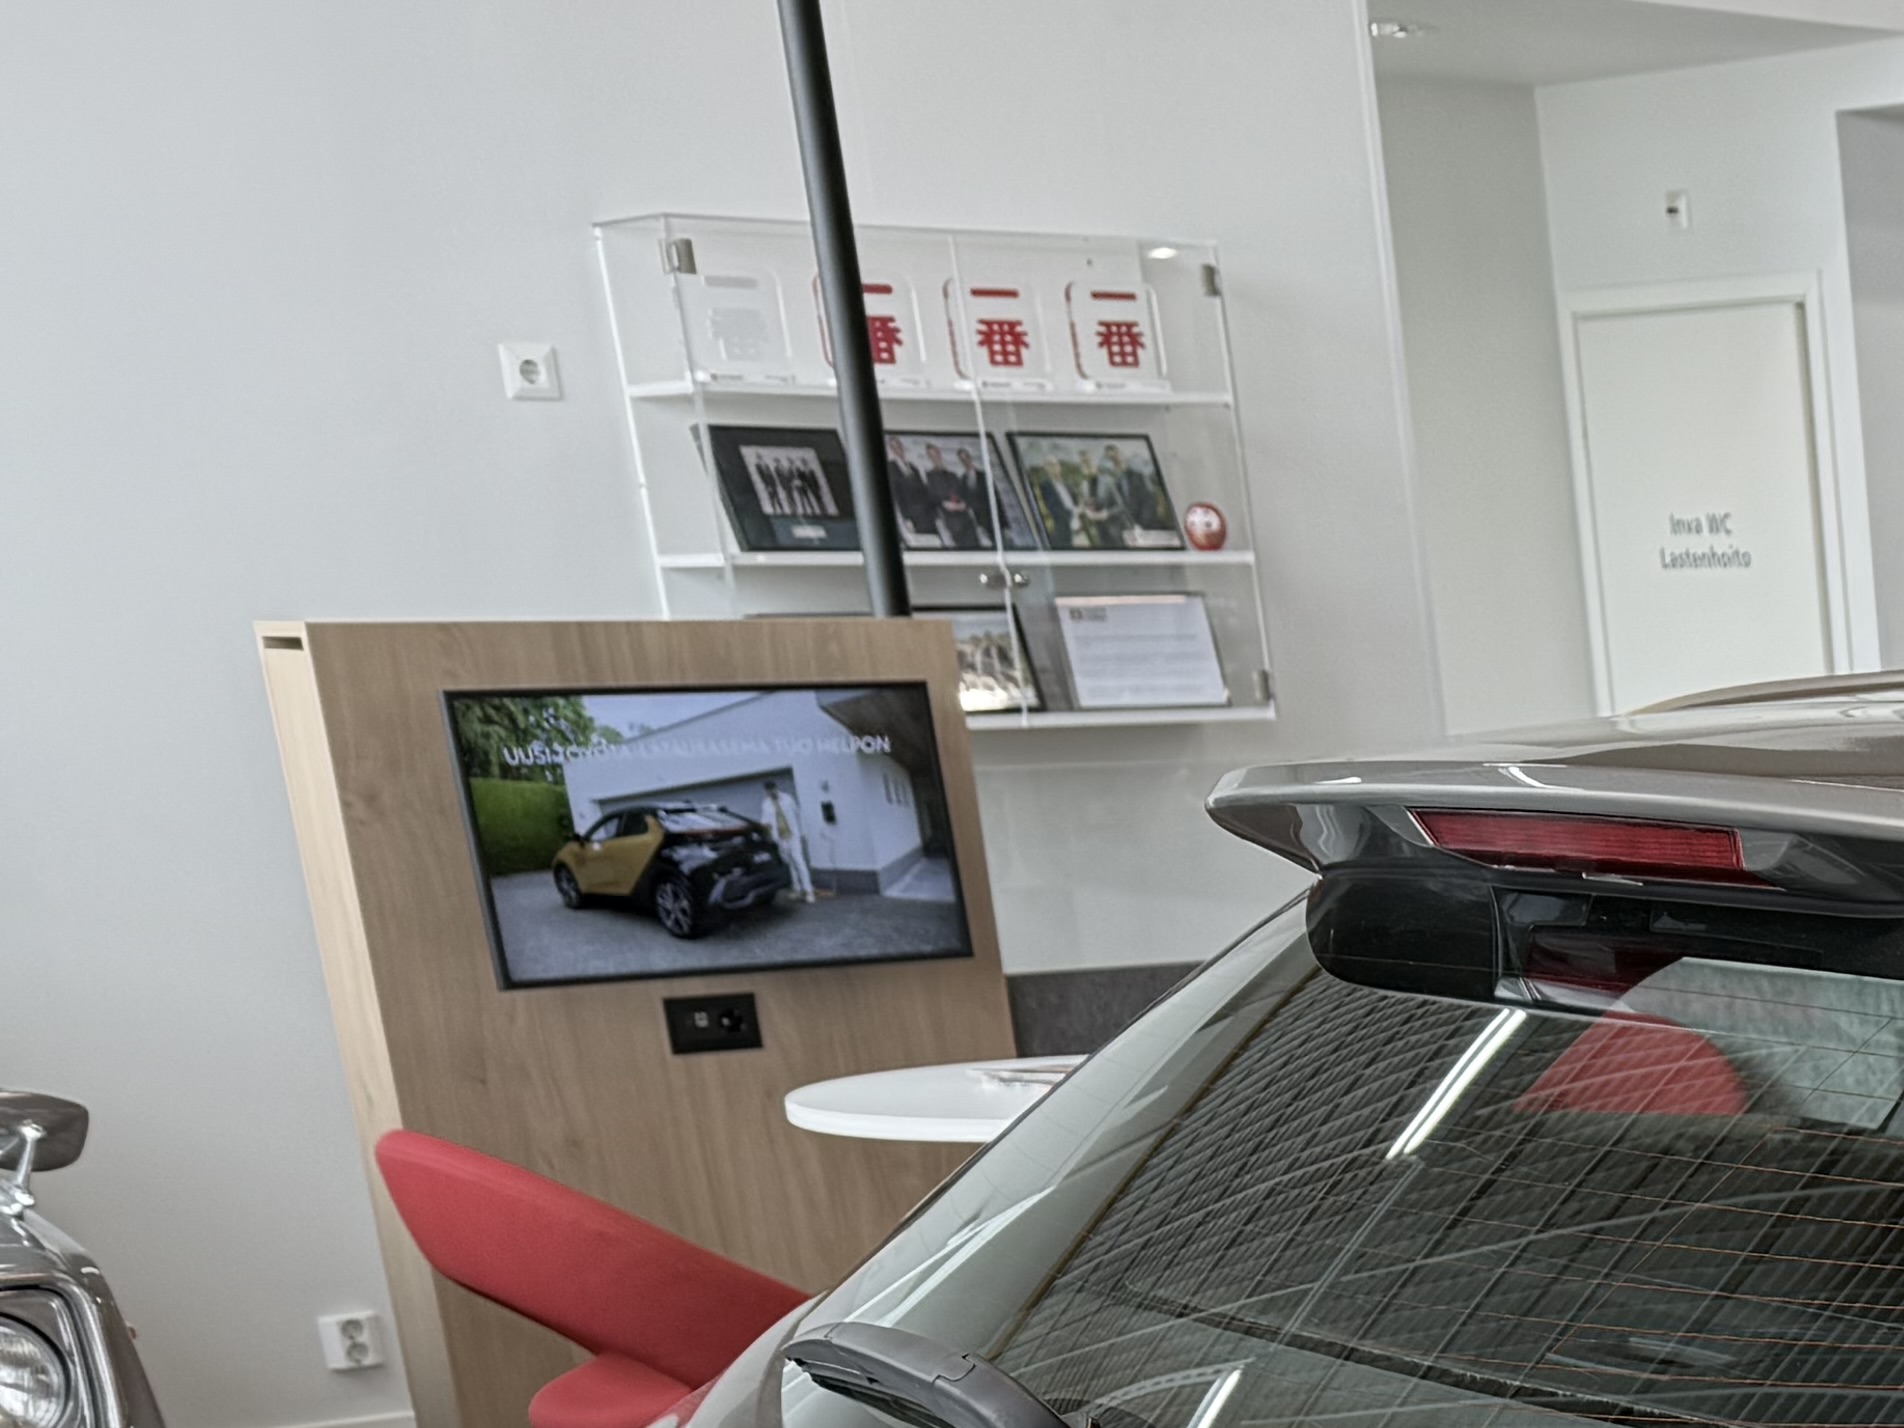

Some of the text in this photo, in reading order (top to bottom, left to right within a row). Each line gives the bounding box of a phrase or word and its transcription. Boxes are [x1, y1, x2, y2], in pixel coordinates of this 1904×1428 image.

[970, 288, 1030, 368] 一番
[1090, 290, 1146, 368] 一番
[1669, 512, 1732, 535] Inva WC
[1659, 544, 1752, 569] Lastenhoito
[504, 746, 550, 766] UUSI
[818, 735, 891, 754] HELPON
